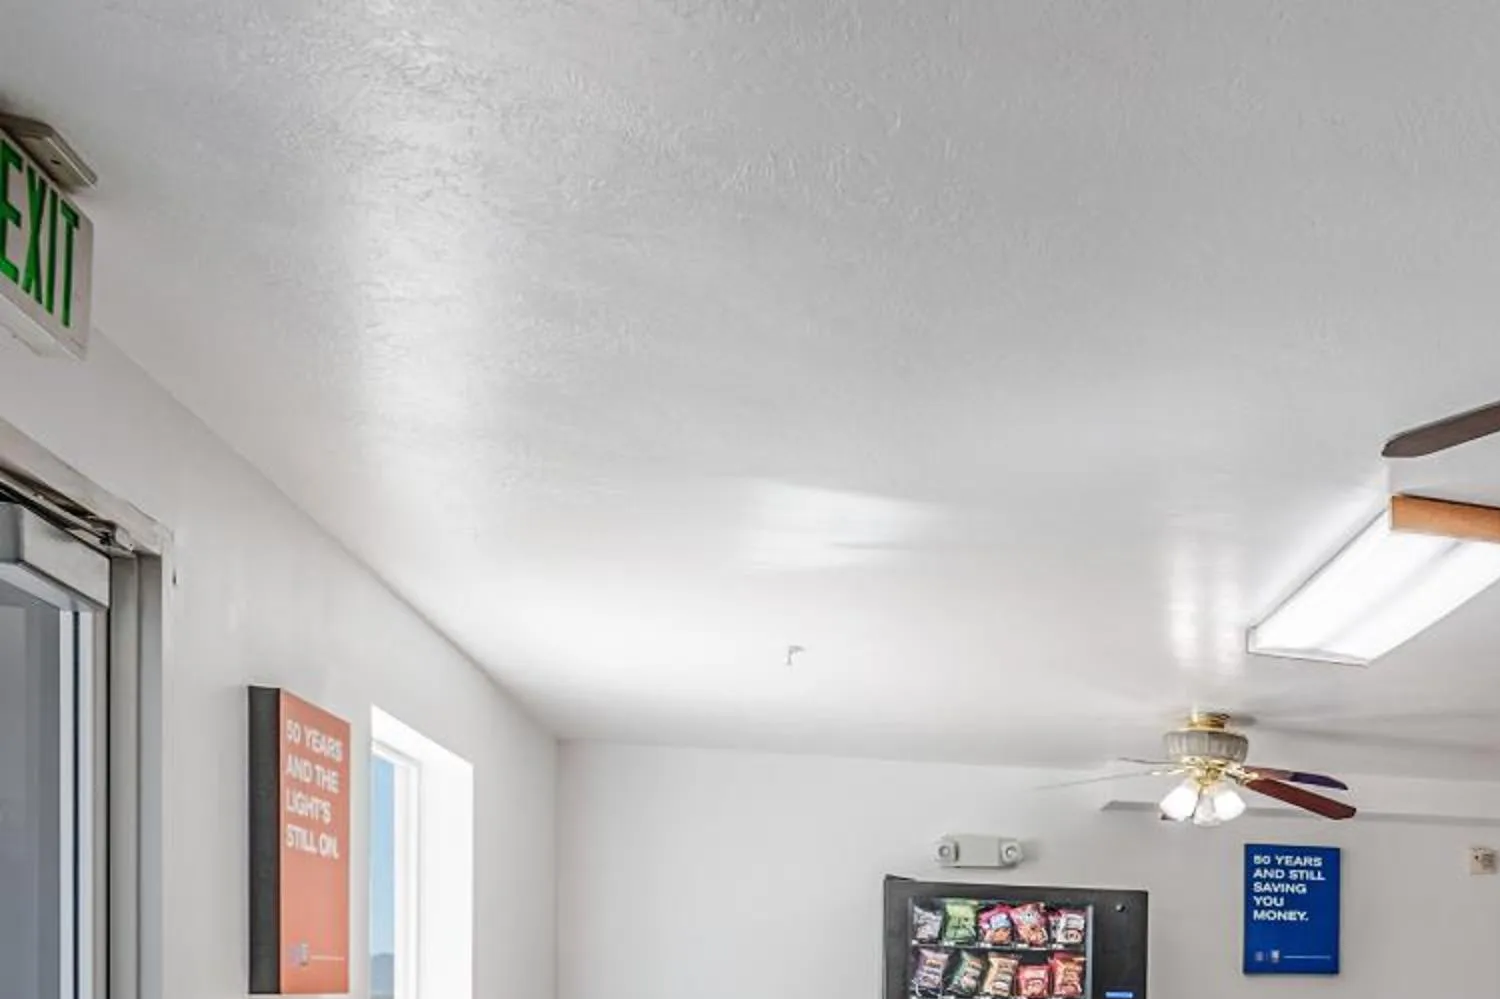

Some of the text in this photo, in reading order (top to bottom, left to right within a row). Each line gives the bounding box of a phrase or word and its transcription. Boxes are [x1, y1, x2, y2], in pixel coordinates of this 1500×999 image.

[0, 138, 80, 328] EXIT
[286, 719, 343, 762] 50 YEARS
[286, 753, 339, 794] AND THE
[286, 823, 340, 860] STILL ON.
[1253, 855, 1323, 867] 50 YEARS
[1253, 868, 1326, 881] AND STILL
[1253, 882, 1307, 894] SAVING
[1253, 896, 1285, 907] YOU
[1253, 910, 1309, 921] MONEY.
